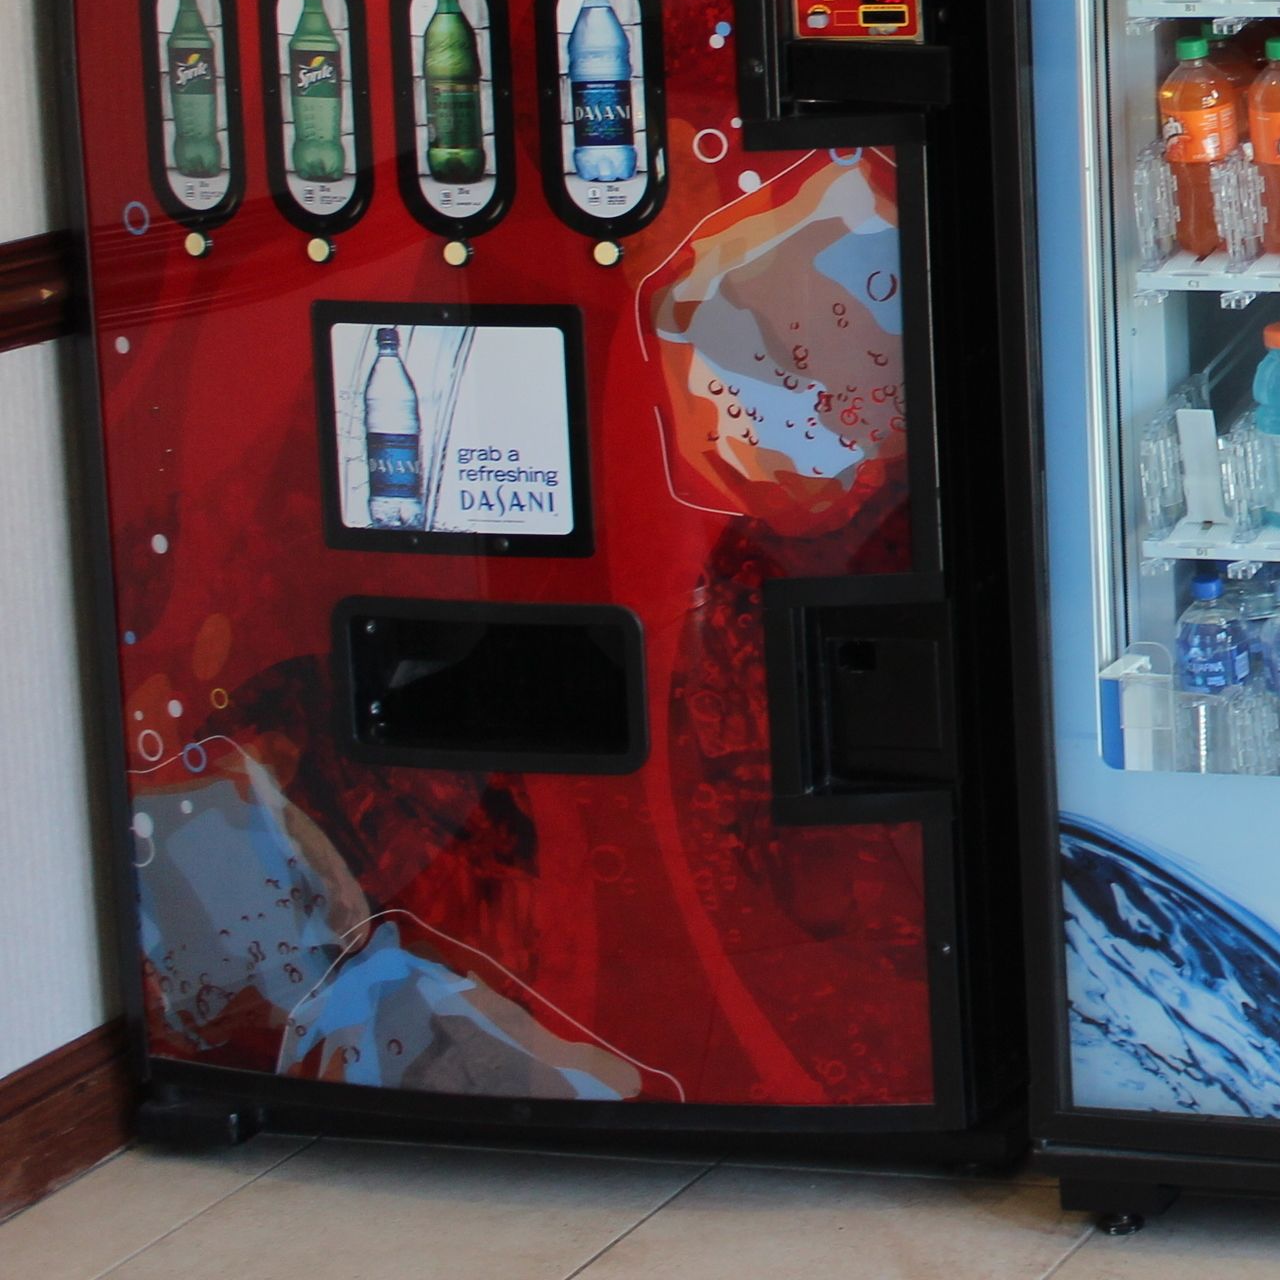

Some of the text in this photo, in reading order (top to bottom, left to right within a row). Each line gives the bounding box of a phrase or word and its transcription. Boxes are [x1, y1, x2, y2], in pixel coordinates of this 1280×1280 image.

[297, 64, 336, 89] Sprite
[575, 104, 631, 122] DASANI
[457, 445, 520, 464] grab a
[458, 466, 559, 487] refreshing
[460, 485, 555, 517] DASANI
